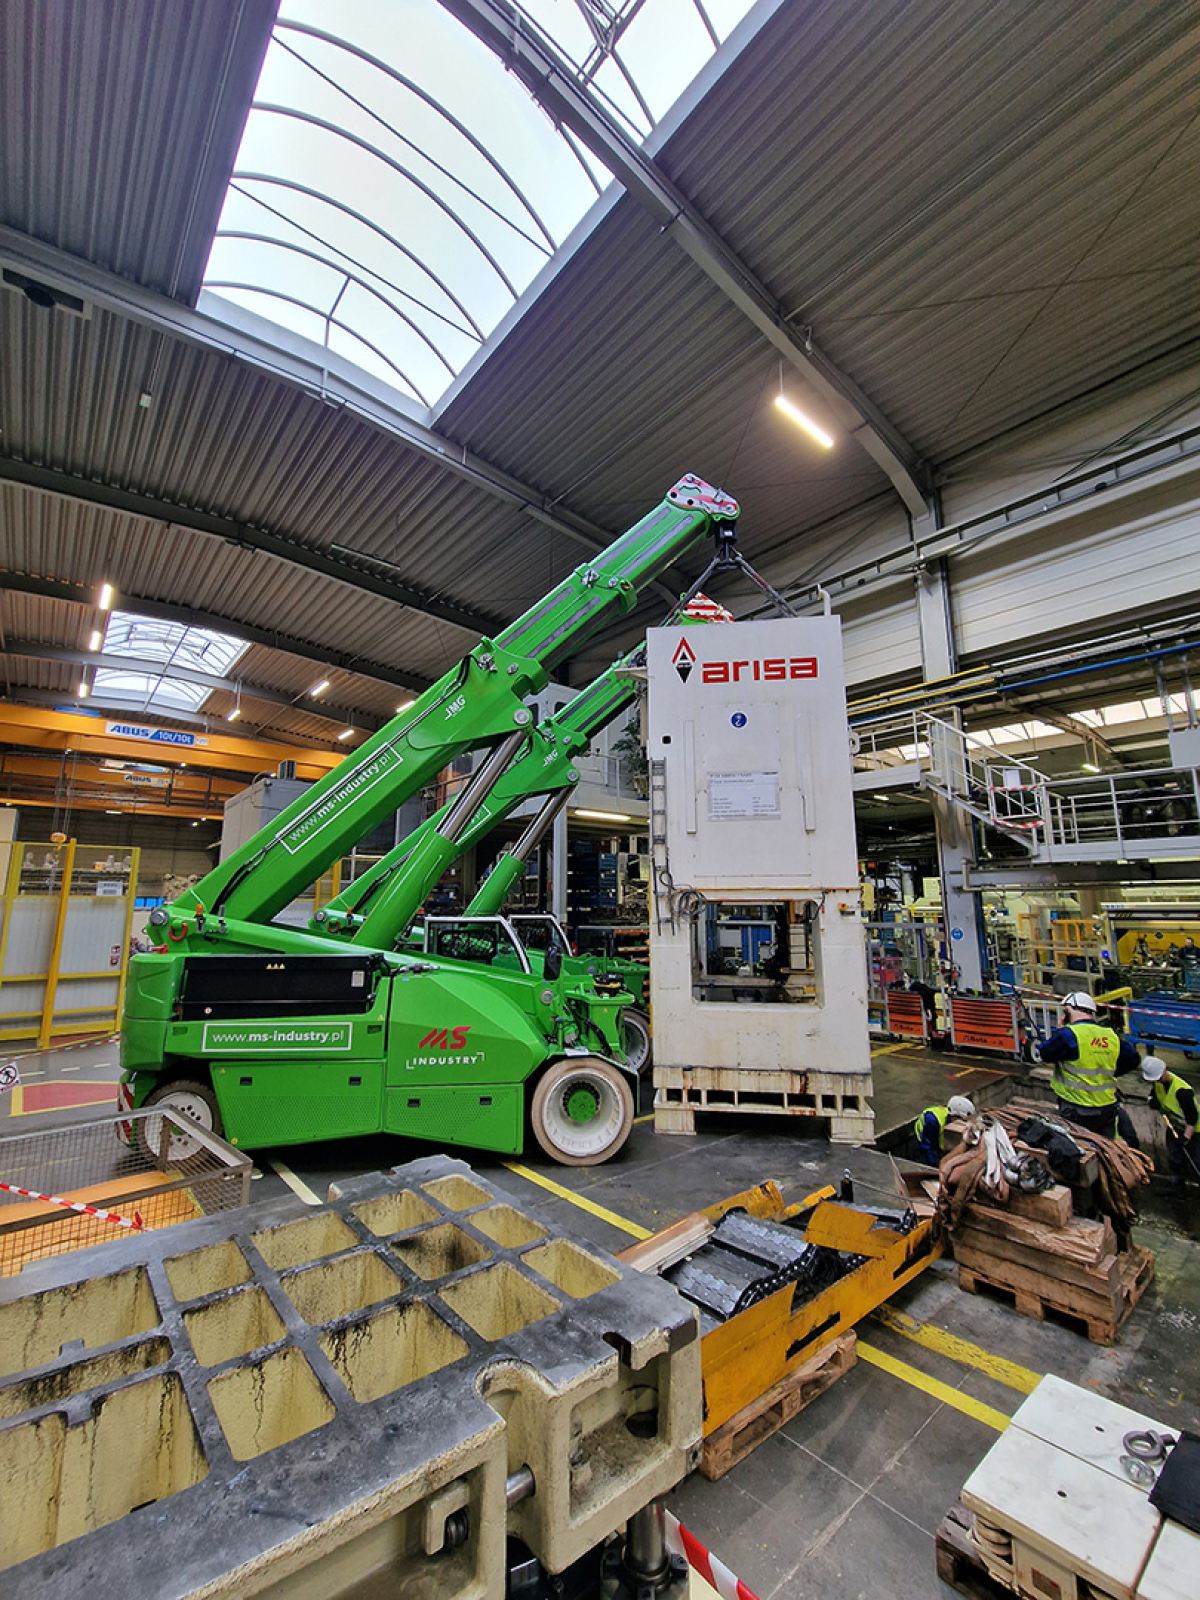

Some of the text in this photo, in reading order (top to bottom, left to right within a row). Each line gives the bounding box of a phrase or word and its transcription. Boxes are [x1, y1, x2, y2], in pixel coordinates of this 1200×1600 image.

[702, 657, 818, 684] arisa
[444, 694, 466, 720] JMG
[110, 725, 150, 737] ABUS
[289, 753, 391, 842] www.ms-industry.pl
[212, 1030, 344, 1044] www.ms-industry.pl
[418, 1025, 472, 1051] MS
[1091, 1036, 1109, 1049] MS
[413, 1055, 478, 1067] INDUSTRY
